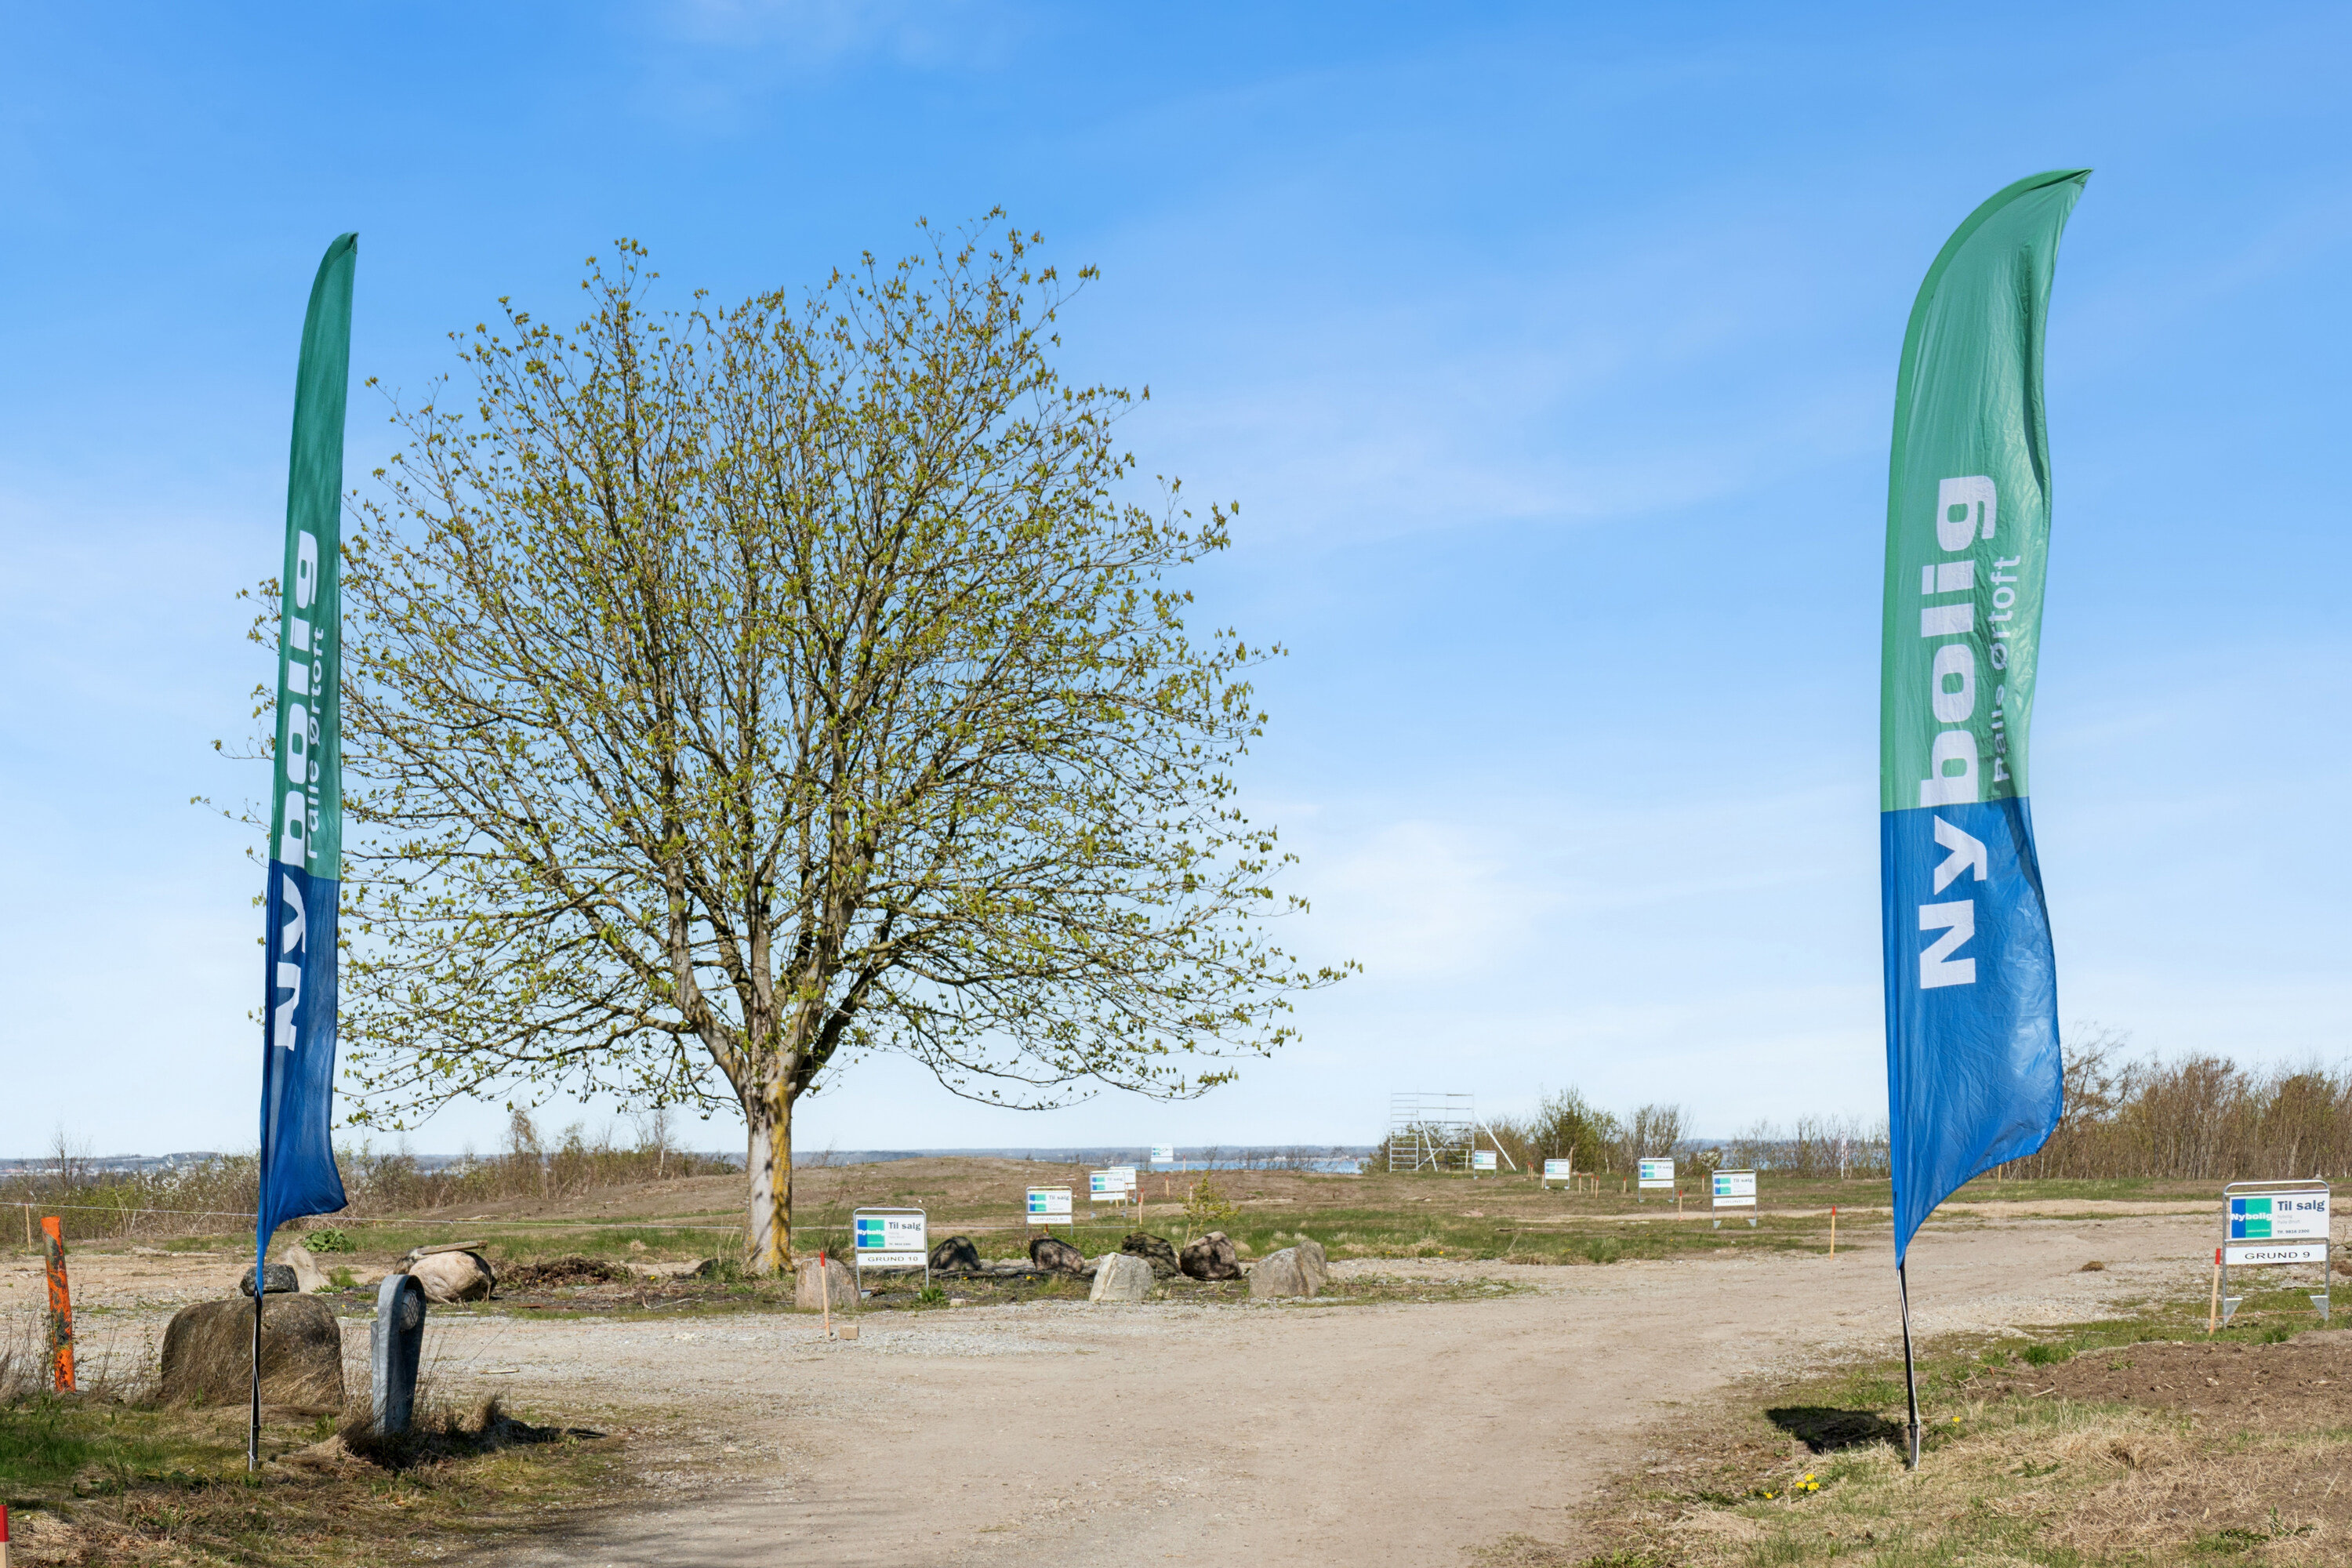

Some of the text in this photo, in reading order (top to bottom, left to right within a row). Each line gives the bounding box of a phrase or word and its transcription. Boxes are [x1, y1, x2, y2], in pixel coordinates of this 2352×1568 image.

[1987, 555, 2020, 670] Ørtoft
[309, 627, 324, 746] Ørtoft
[1919, 475, 1996, 989] Nybolig
[274, 530, 318, 1051] Nybolig
[902, 1222, 921, 1231] salg
[2230, 1212, 2272, 1221] Nybolig
[2278, 1200, 2325, 1212] Til salg
